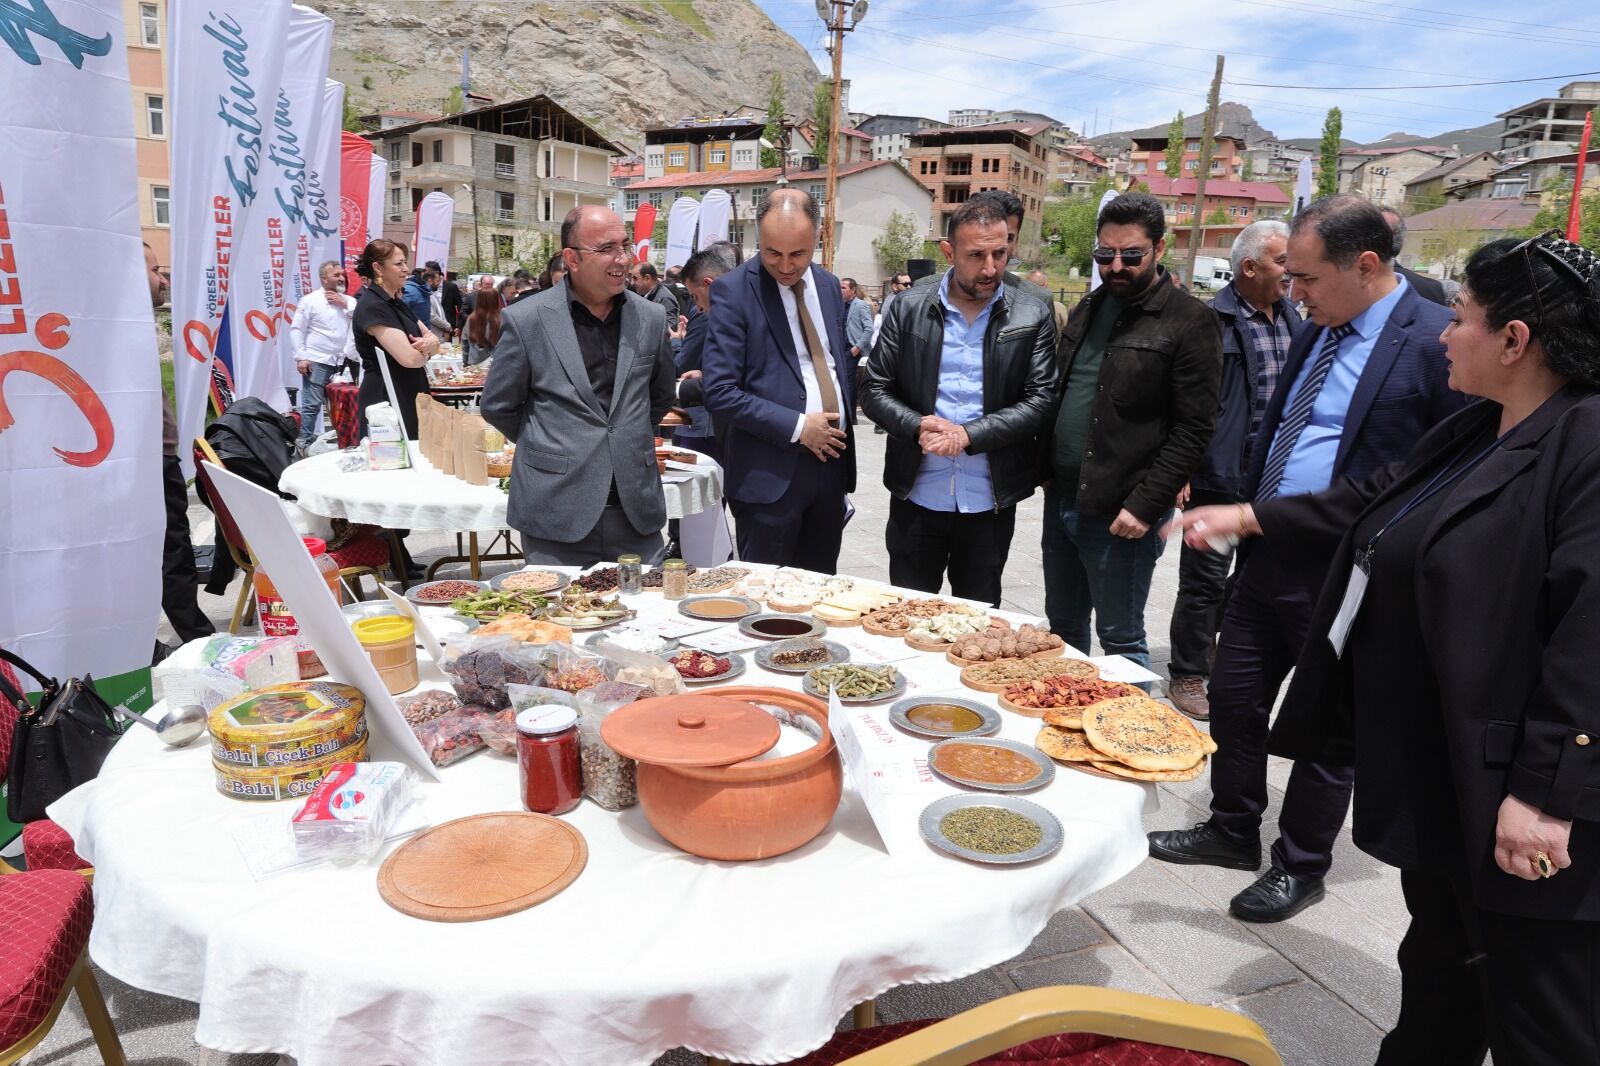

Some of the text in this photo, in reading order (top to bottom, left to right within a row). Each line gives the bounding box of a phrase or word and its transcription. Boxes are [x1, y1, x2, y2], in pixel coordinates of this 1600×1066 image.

[203, 10, 263, 208] Festivali
[207, 265, 217, 318] YÖRESEL
[265, 268, 273, 309] YÖRESEL
[218, 744, 252, 763] Balı
[265, 739, 339, 766] Çiçek Balı
[231, 780, 273, 795] Balı
[287, 776, 325, 797] Çiçe
